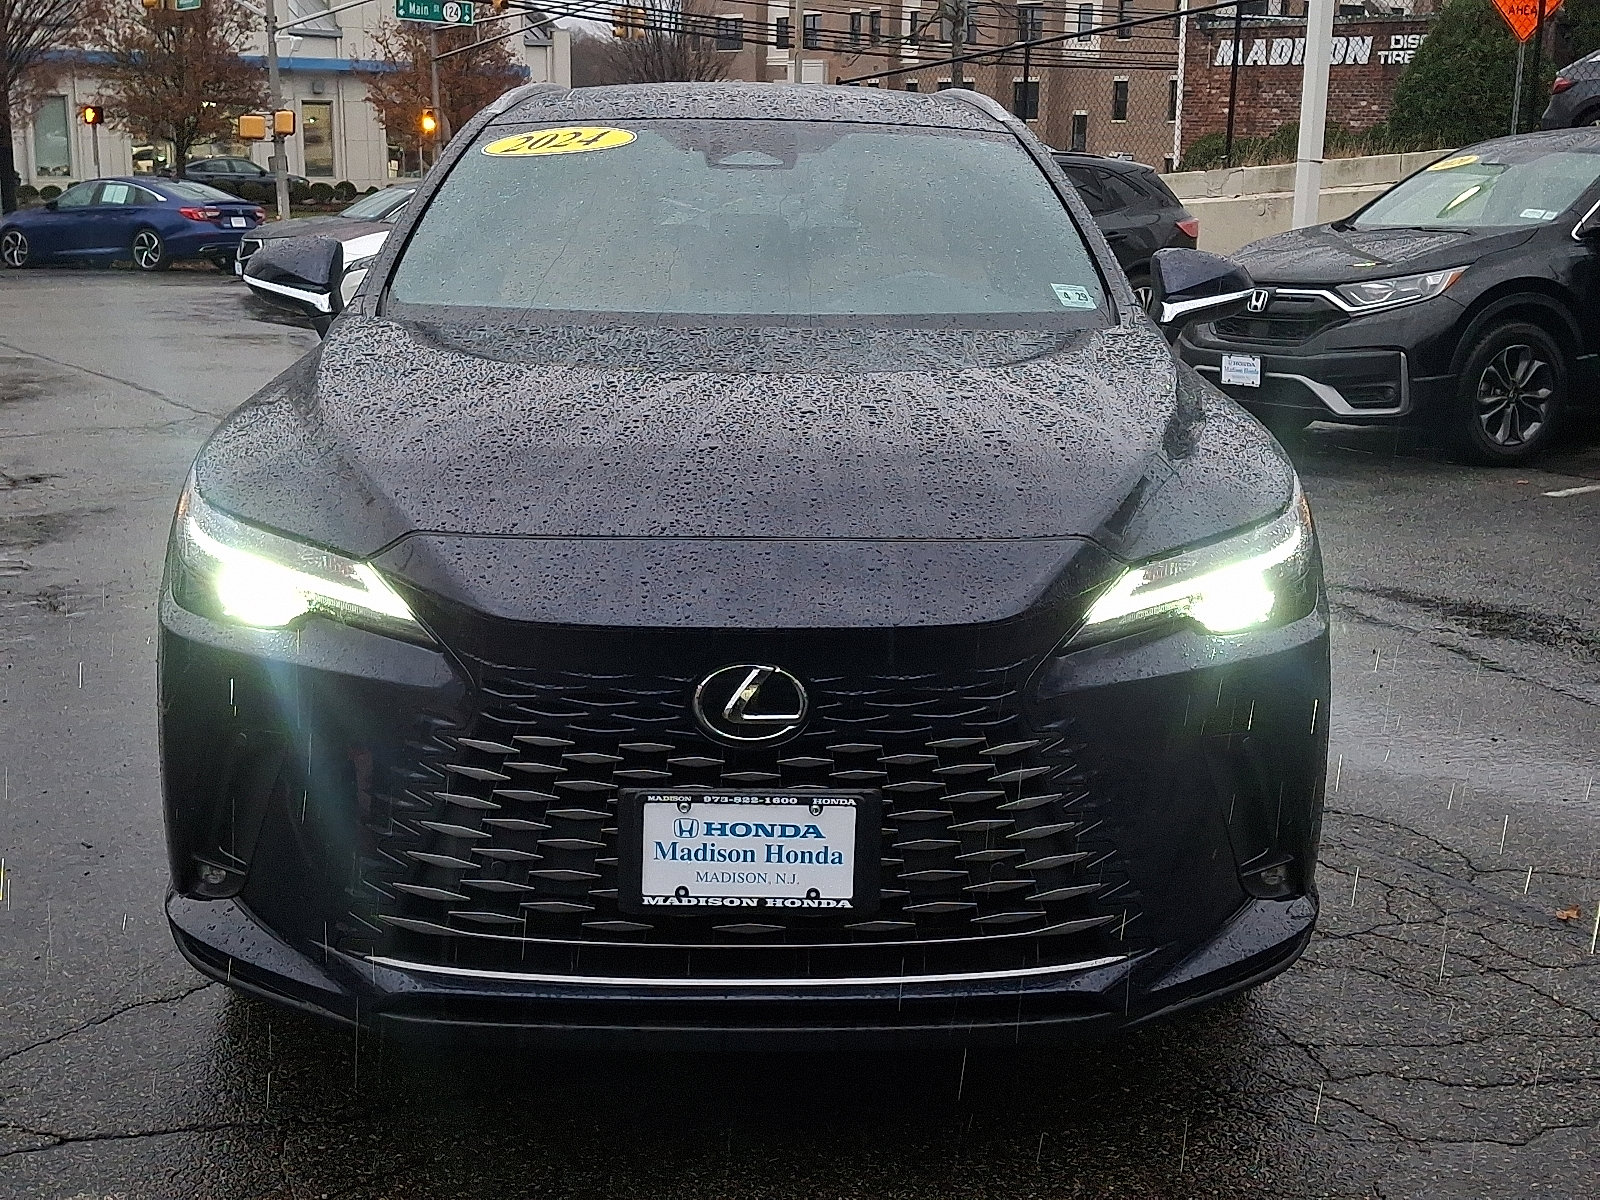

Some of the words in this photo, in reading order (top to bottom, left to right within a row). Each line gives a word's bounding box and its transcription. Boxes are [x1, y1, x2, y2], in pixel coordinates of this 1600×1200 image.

[409, 2, 429, 15] Main
[445, 6, 459, 18] 124
[1508, 4, 1538, 16] AHEA
[1214, 36, 1374, 67] MADION
[500, 131, 611, 154] 2024
[812, 798, 857, 806] HONDA
[703, 821, 826, 839] HONDA
[653, 841, 756, 863] Madison
[765, 843, 844, 865] Honda
[695, 871, 771, 885] MADISON,
[775, 873, 800, 885] N.J.
[641, 896, 758, 907] MADISON
[765, 898, 854, 909] HONDA
